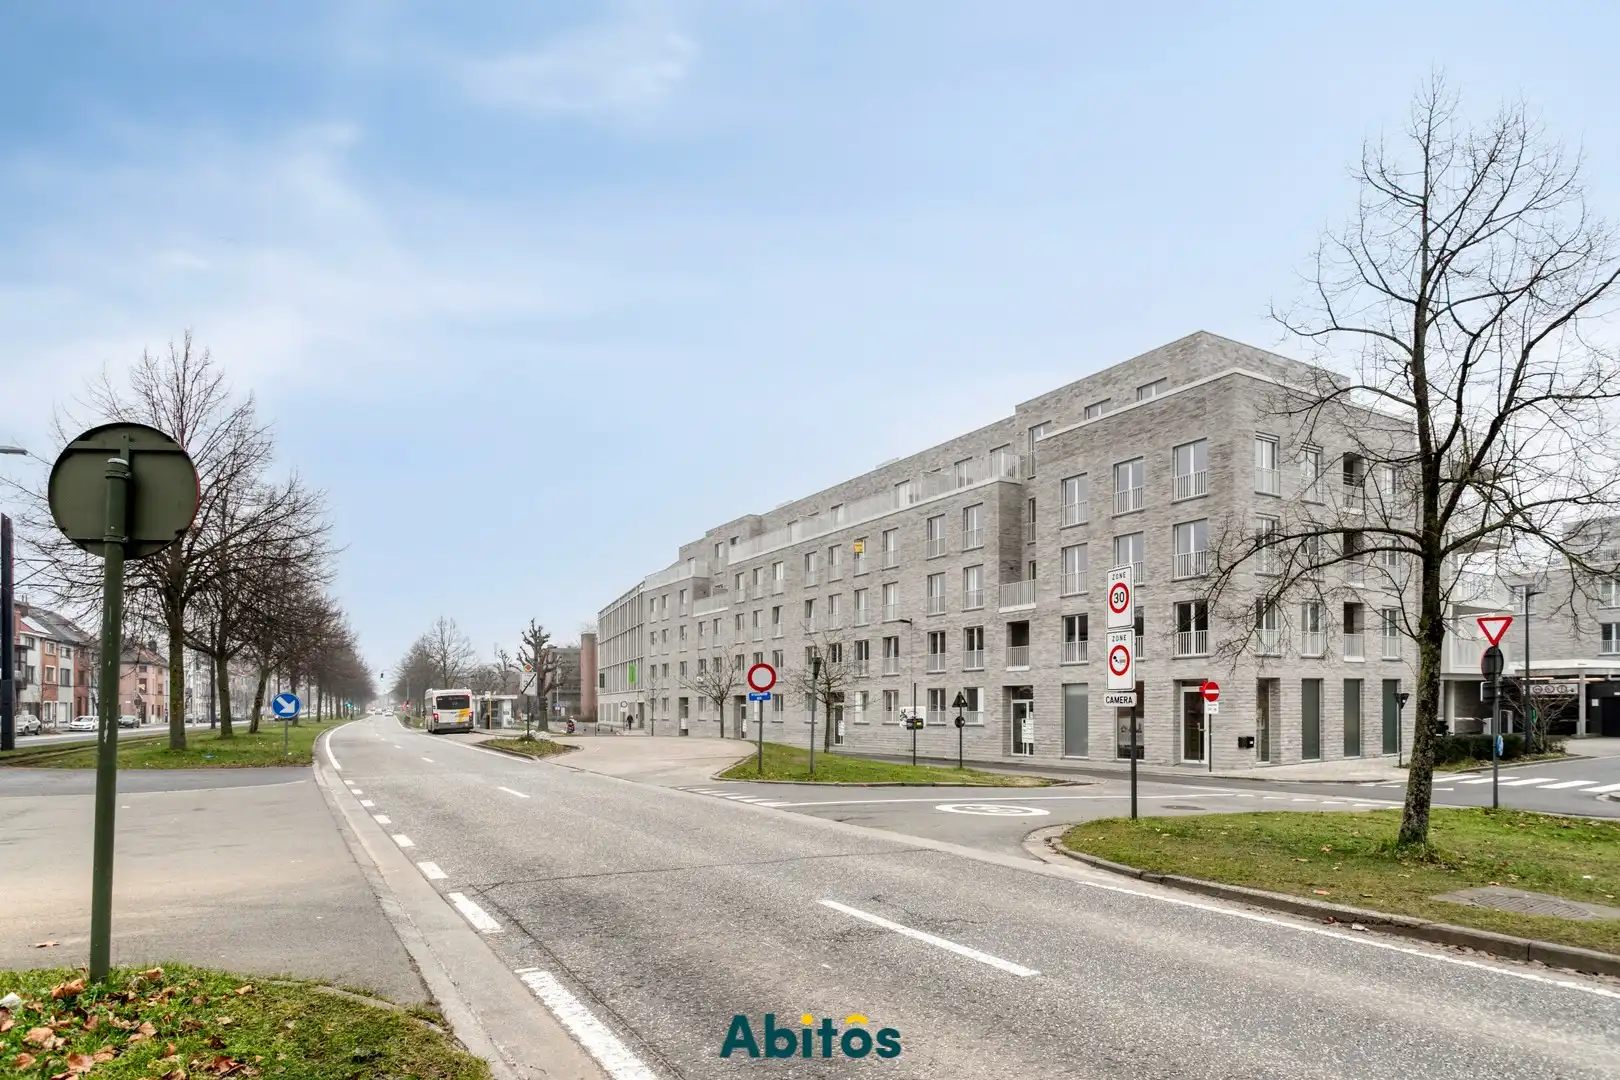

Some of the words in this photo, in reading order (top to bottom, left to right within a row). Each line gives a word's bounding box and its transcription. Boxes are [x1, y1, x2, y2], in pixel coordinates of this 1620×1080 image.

[1111, 571, 1126, 580] ZONE
[1113, 591, 1125, 604] 30
[1111, 634, 1127, 643] ZONE
[1105, 695, 1133, 704] CAMERA
